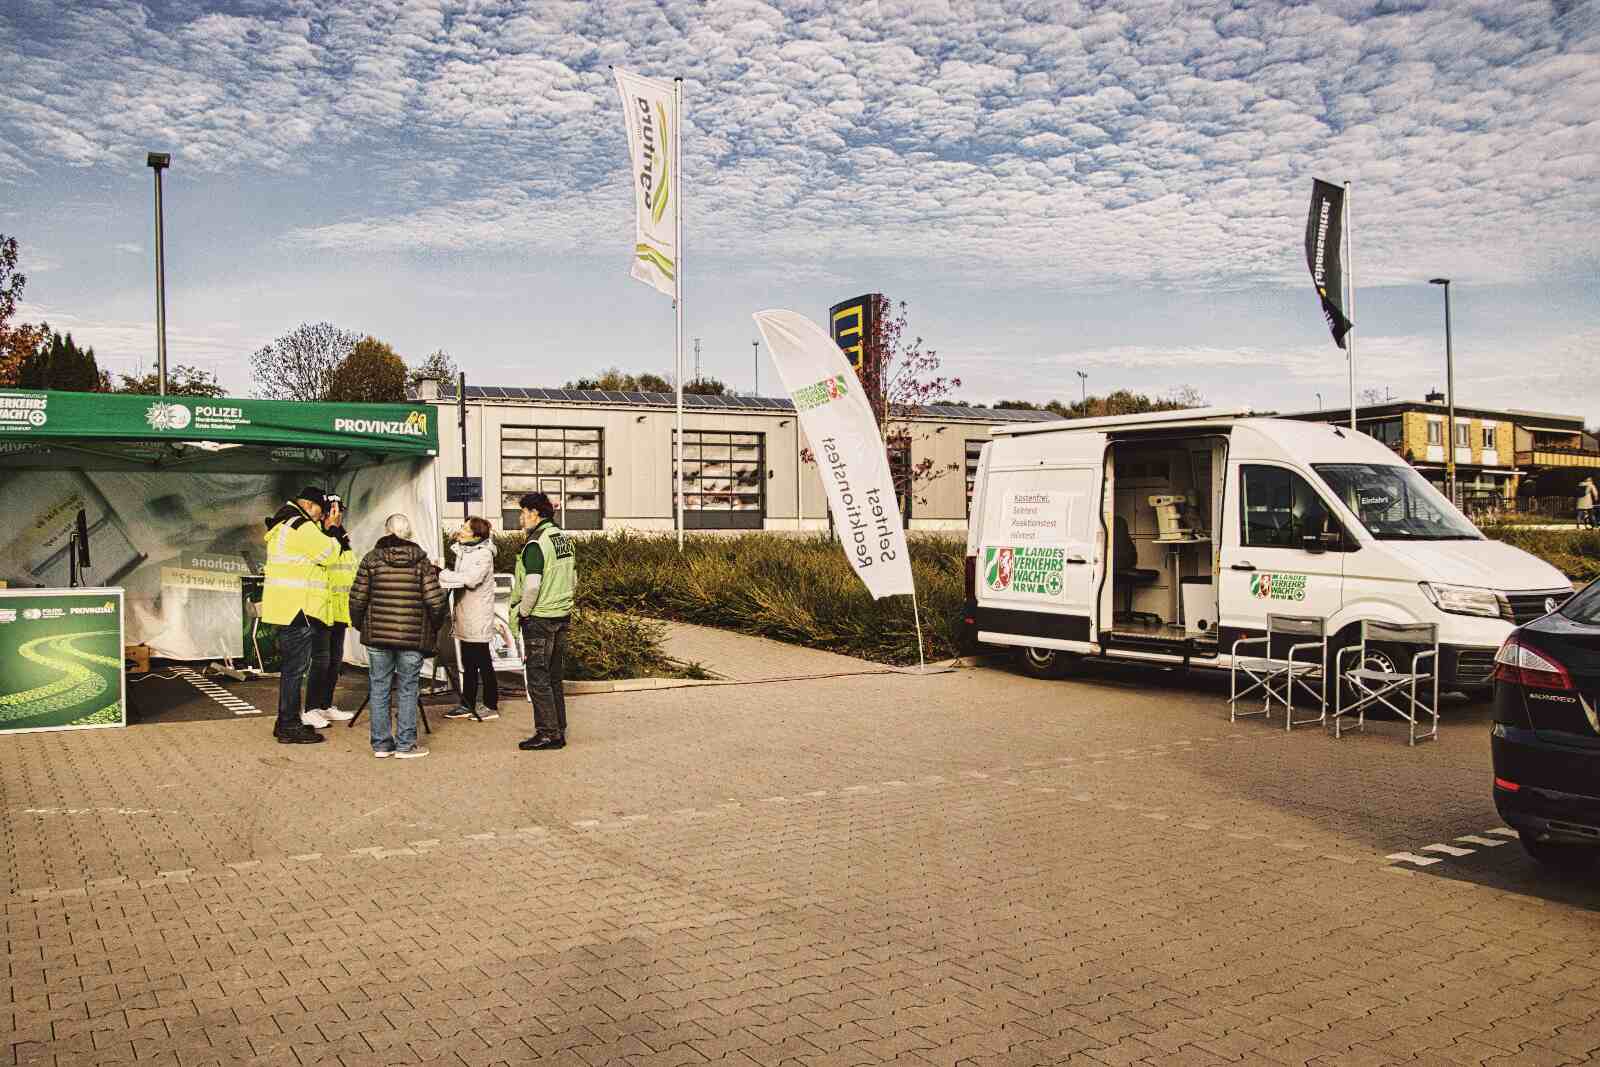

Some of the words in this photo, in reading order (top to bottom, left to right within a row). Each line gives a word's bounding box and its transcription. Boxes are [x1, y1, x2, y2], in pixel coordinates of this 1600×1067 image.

[0, 398, 48, 410] ERKEHRS
[195, 406, 243, 418] POLIZEI
[334, 418, 423, 436] PROVINZIAL
[1024, 547, 1065, 558] LANDES
[1013, 557, 1064, 571] VERKEHRS
[1013, 570, 1048, 582] WACHT
[1013, 583, 1036, 593] NRW
[1529, 692, 1576, 703] MONDEO
